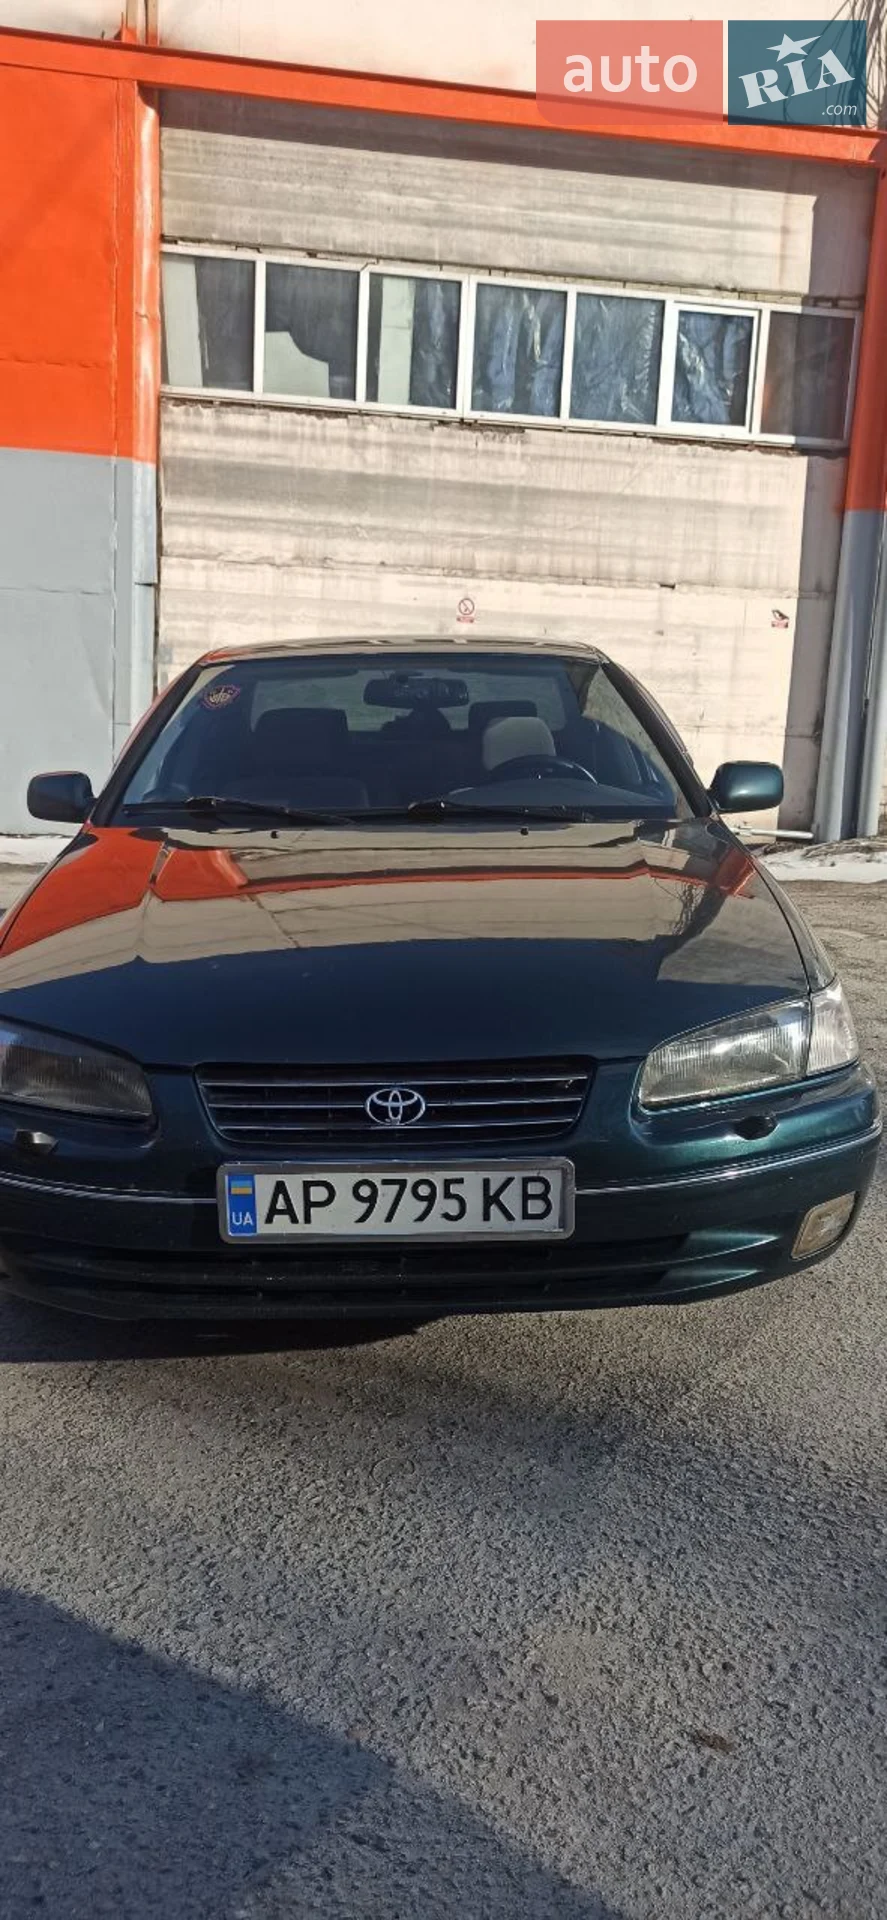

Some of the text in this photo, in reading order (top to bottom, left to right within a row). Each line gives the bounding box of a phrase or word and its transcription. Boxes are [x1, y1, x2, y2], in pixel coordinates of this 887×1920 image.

[264, 1176, 553, 1225] AP 9795 KB
[231, 1211, 254, 1226] UA
